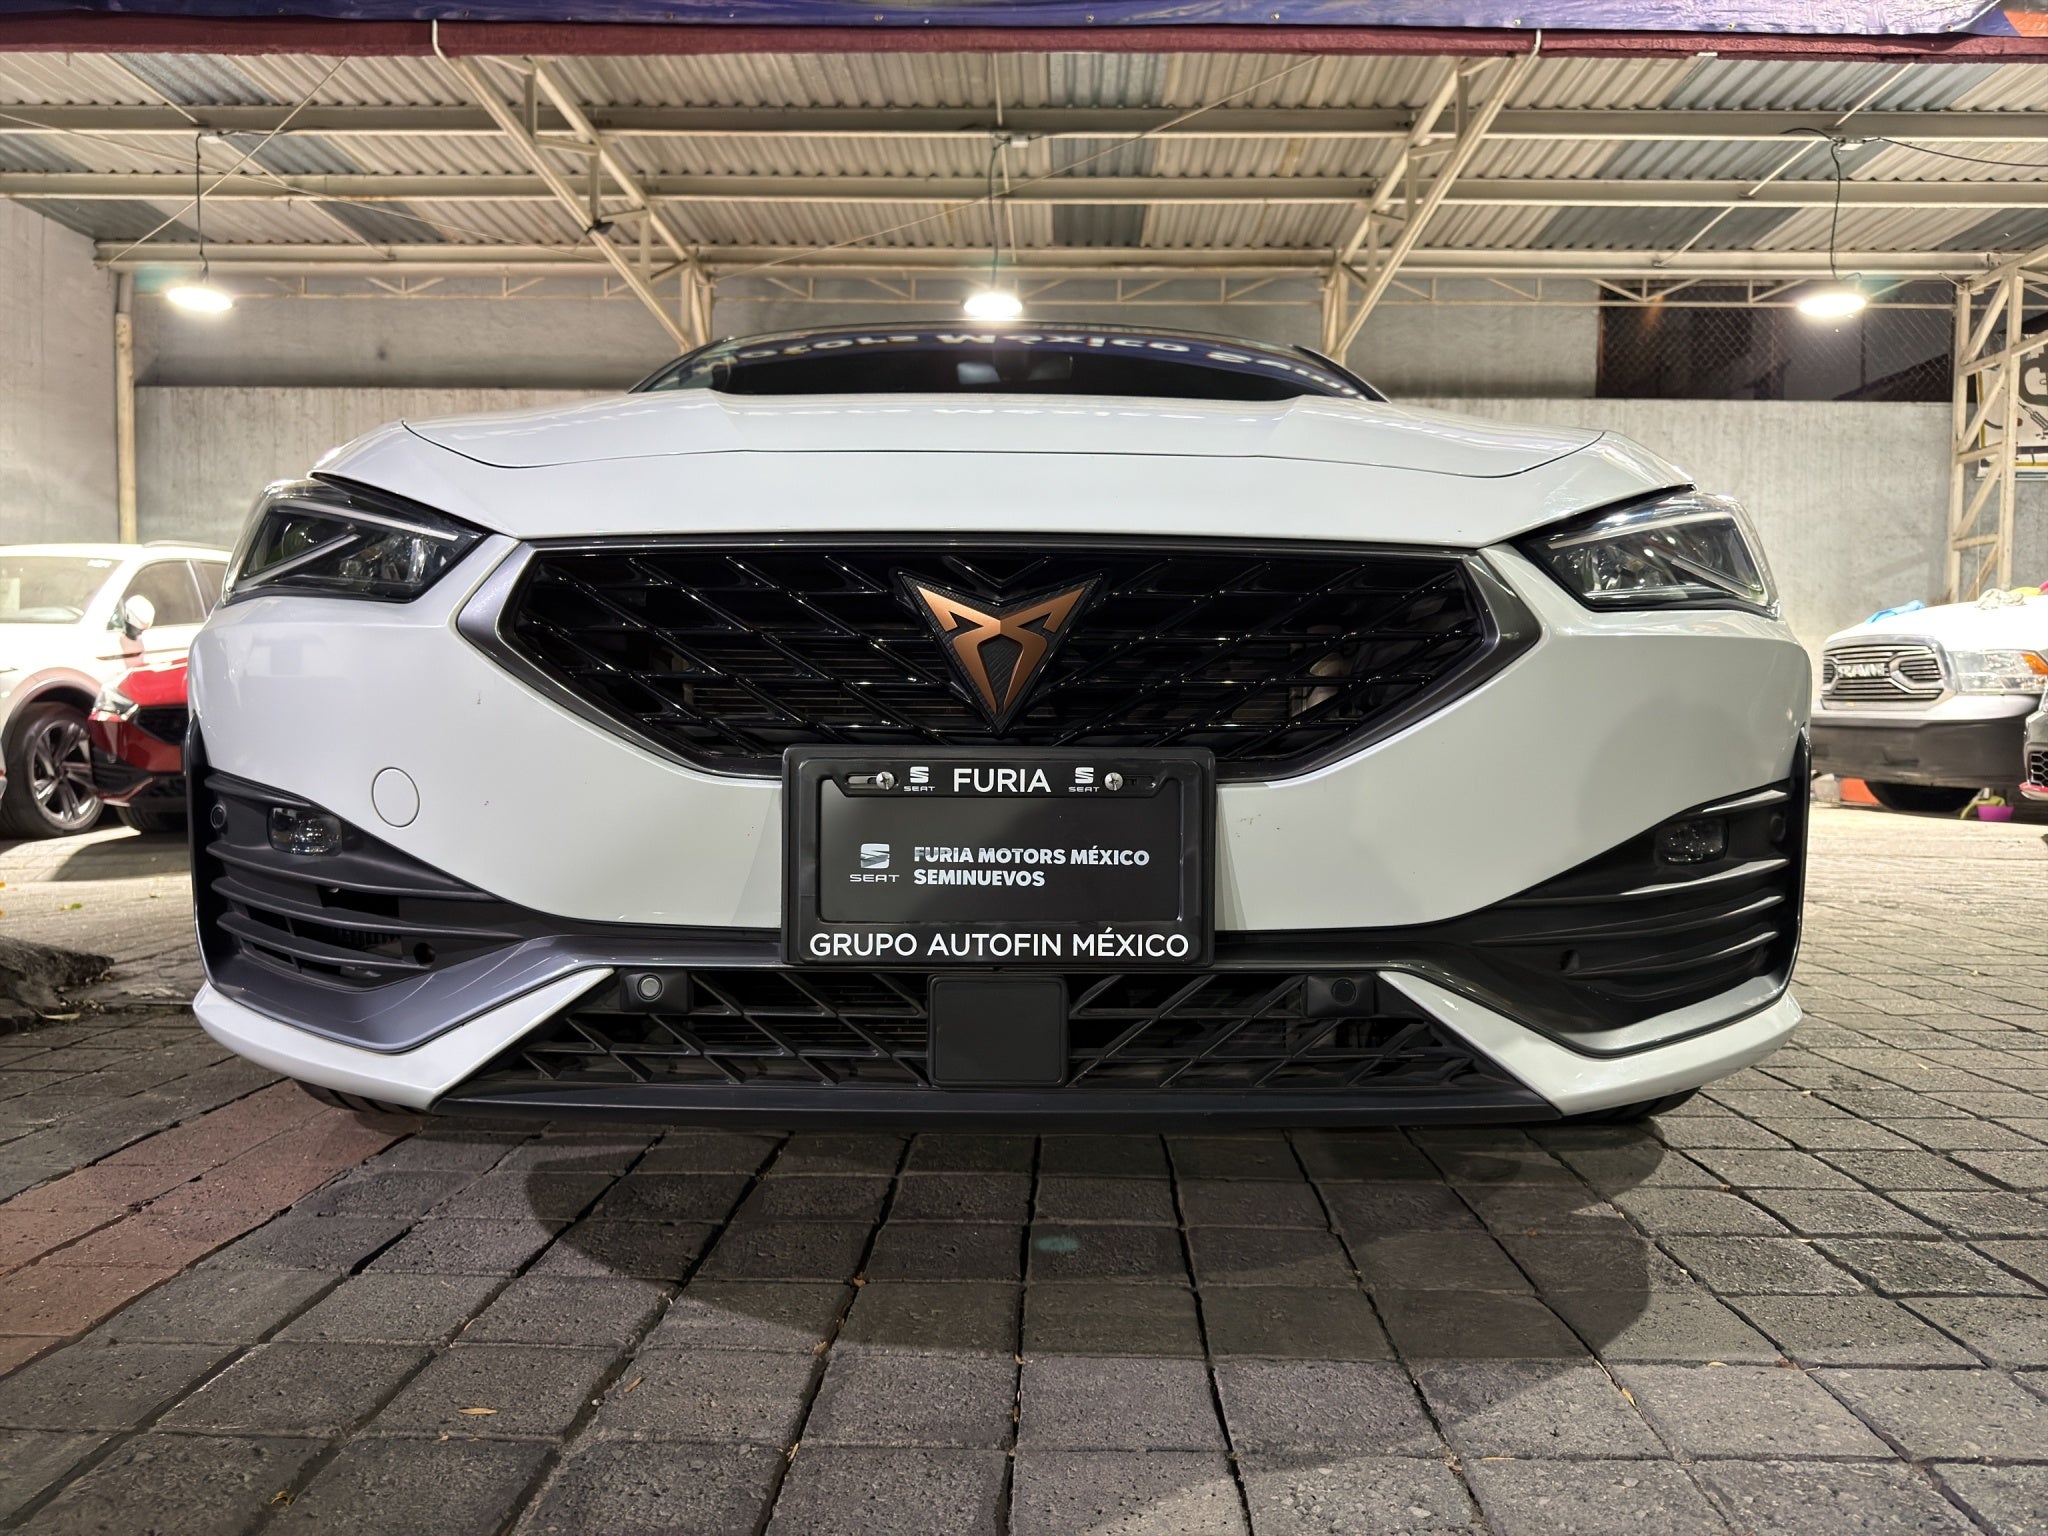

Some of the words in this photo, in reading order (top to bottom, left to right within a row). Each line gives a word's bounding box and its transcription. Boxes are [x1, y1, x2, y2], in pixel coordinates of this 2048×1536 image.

[1838, 663, 1885, 678] RAM
[953, 768, 1052, 793] FURIA
[913, 846, 975, 864] FURIA
[977, 847, 1067, 866] MOTORS
[1070, 844, 1150, 867] MÉXICO
[849, 873, 900, 883] SEAT
[913, 869, 1046, 887] SEMINUEVOS
[809, 932, 918, 958] GRUPO
[926, 933, 1062, 957] AUTOFIN
[1072, 926, 1190, 958] MÉXICO
